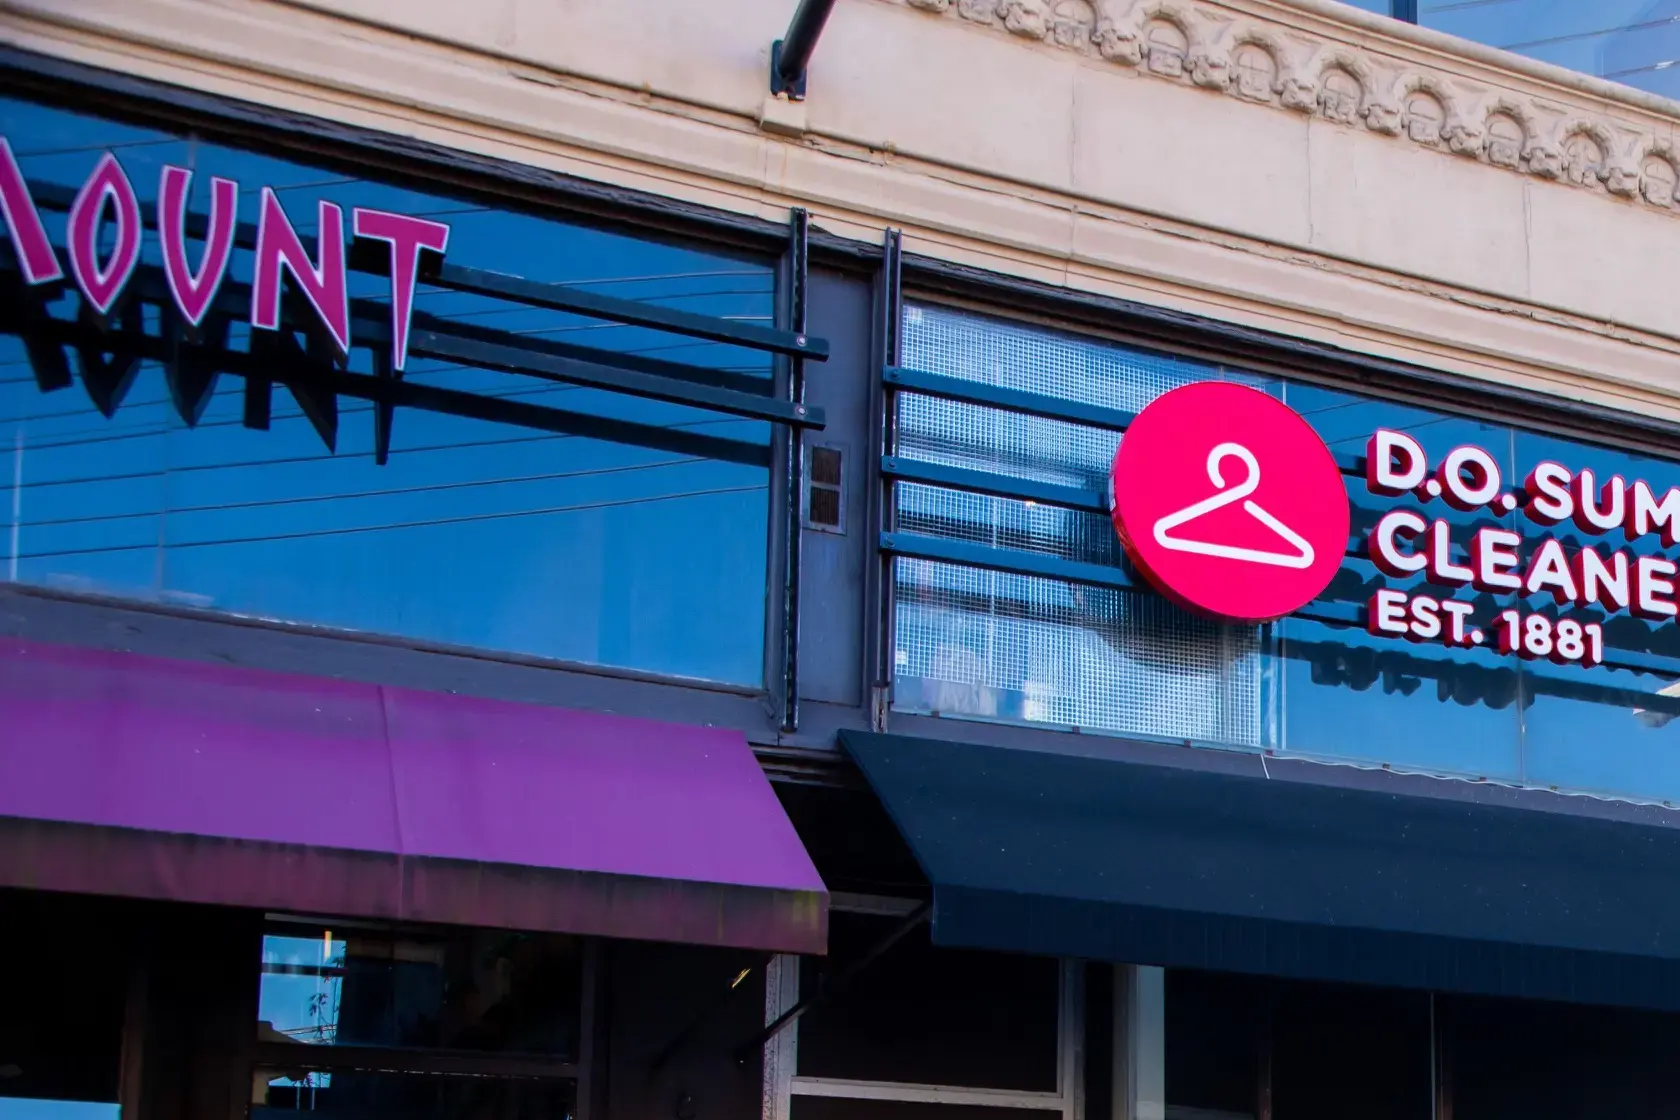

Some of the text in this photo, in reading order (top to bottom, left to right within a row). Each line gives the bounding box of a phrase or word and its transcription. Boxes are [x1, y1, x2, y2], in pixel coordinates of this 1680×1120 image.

[1366, 428, 1517, 515] D.O.
[1368, 589, 1604, 667] EST. 1881
